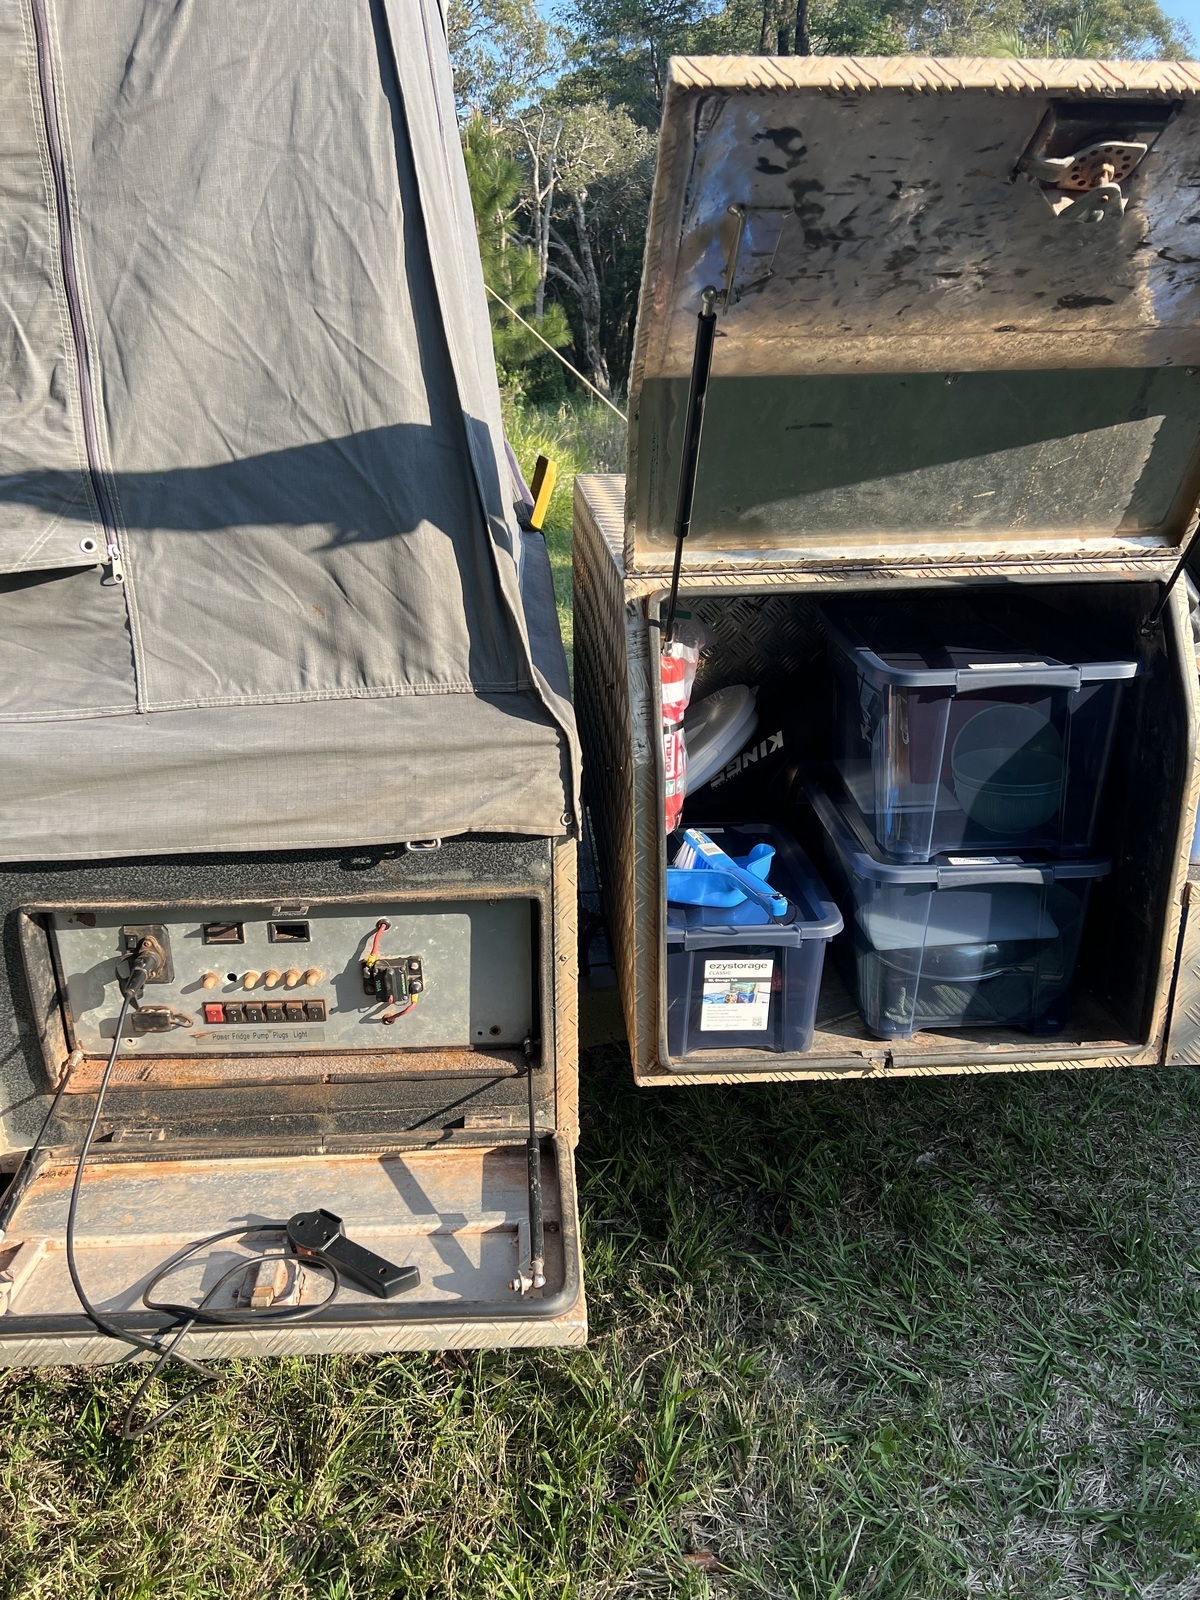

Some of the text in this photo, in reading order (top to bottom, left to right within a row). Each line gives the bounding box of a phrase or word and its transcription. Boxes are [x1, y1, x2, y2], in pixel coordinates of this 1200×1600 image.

[665, 736, 673, 773] QUELL
[709, 962, 768, 970] ezystorage
[212, 1030, 308, 1041] Power Fridge Pump Plugs Light
